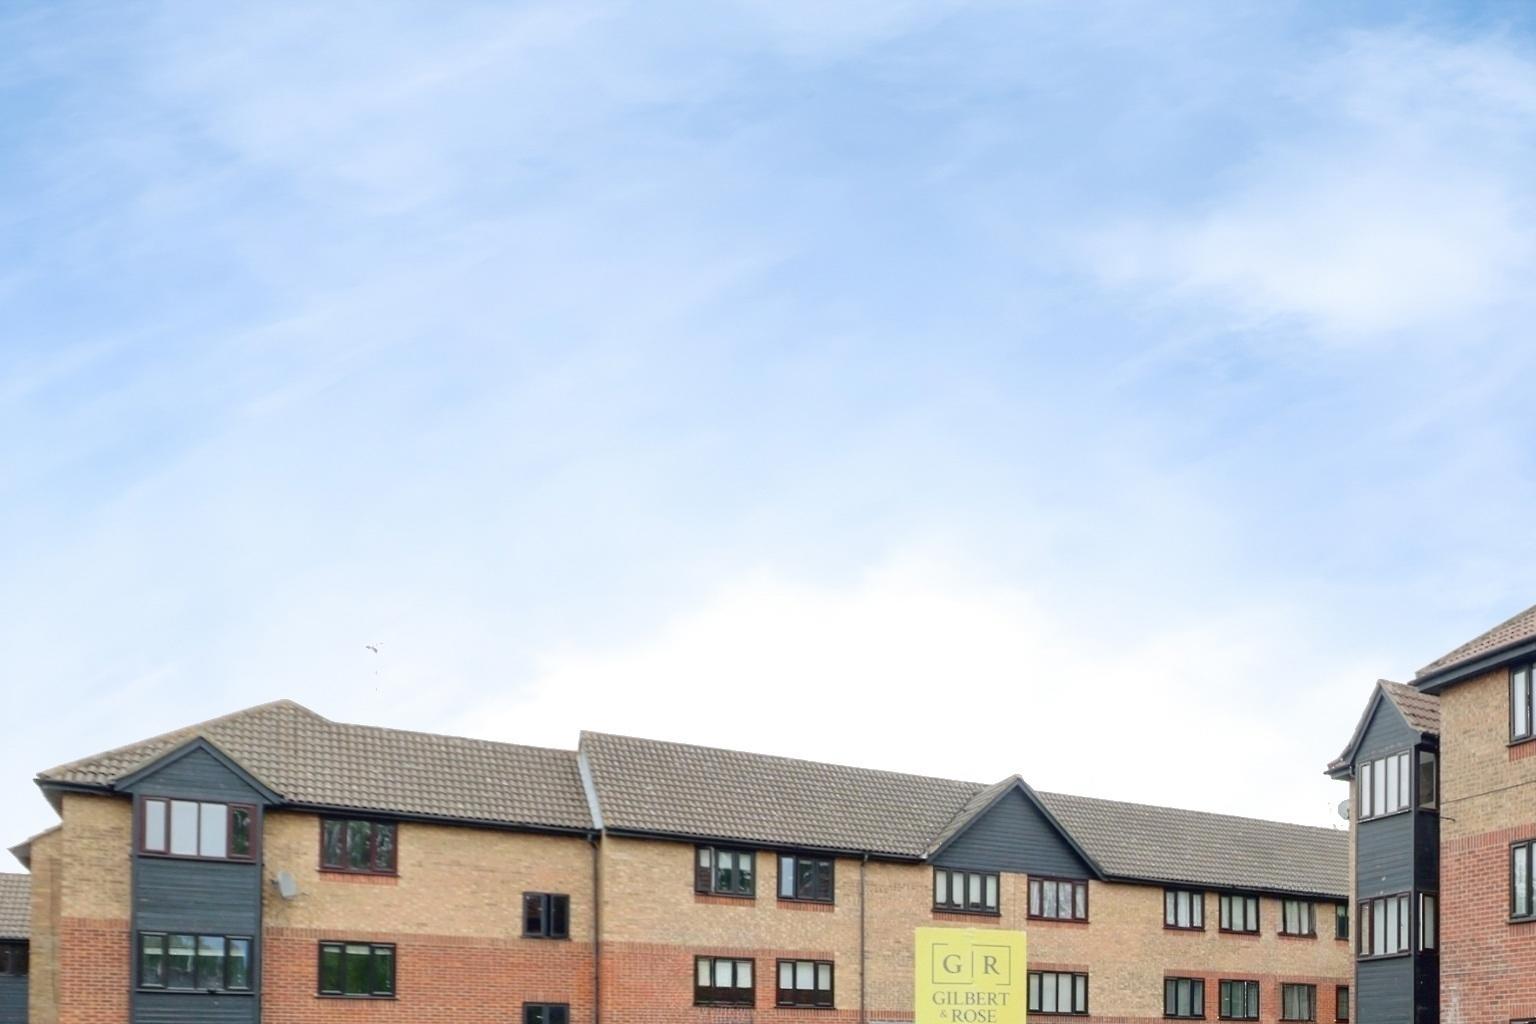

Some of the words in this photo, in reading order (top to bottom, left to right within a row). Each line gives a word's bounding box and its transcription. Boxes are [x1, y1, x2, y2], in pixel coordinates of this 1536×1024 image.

[943, 954, 963, 974] G
[984, 955, 1000, 975] R
[932, 991, 1010, 1006] GILBERT
[939, 1009, 947, 1018] &
[952, 1009, 997, 1023] ROSE
